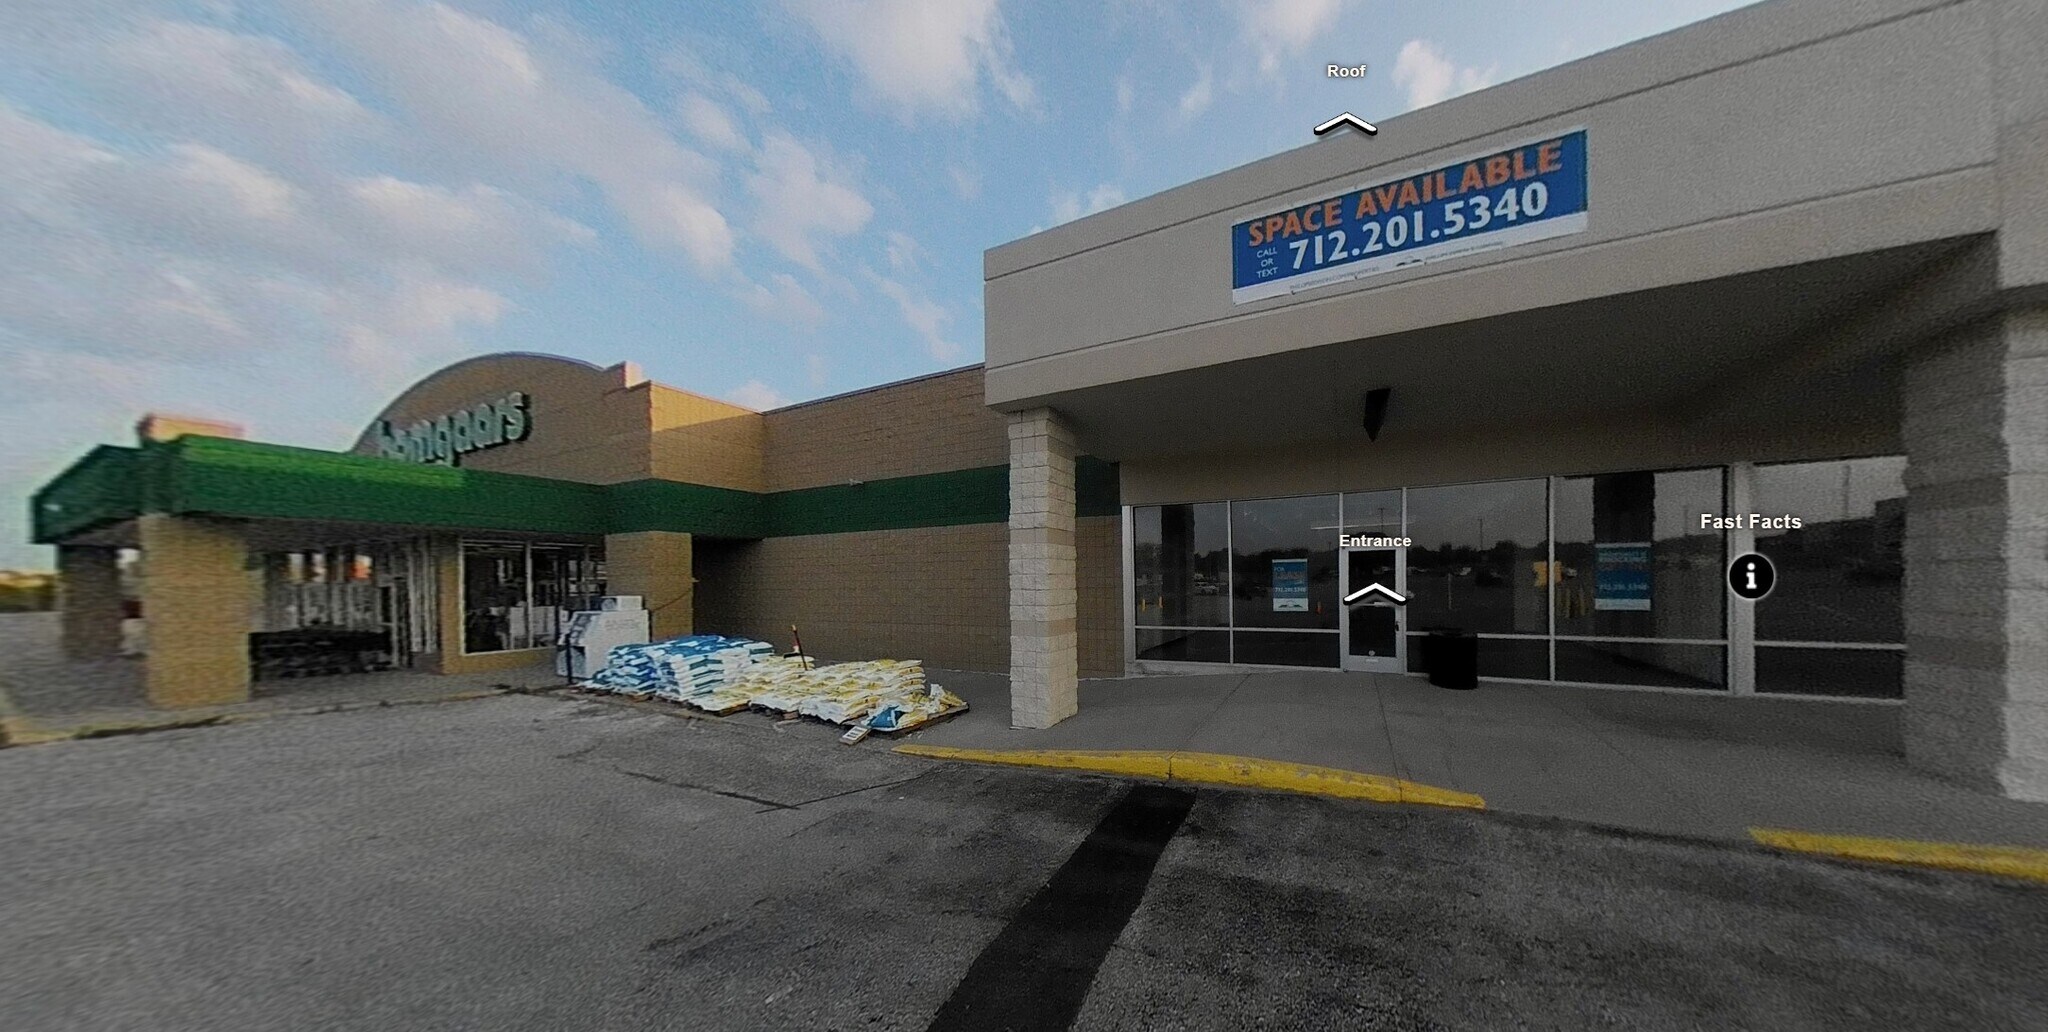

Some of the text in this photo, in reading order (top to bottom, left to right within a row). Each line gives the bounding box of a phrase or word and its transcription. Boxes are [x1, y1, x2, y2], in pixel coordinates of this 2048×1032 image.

[1248, 138, 1563, 247] SPACE AVAILABLE
[1289, 181, 1549, 270] 712.201.5340
[1256, 246, 1277, 259] CALL
[1260, 258, 1275, 268] OR
[1256, 266, 1279, 279] TEXT
